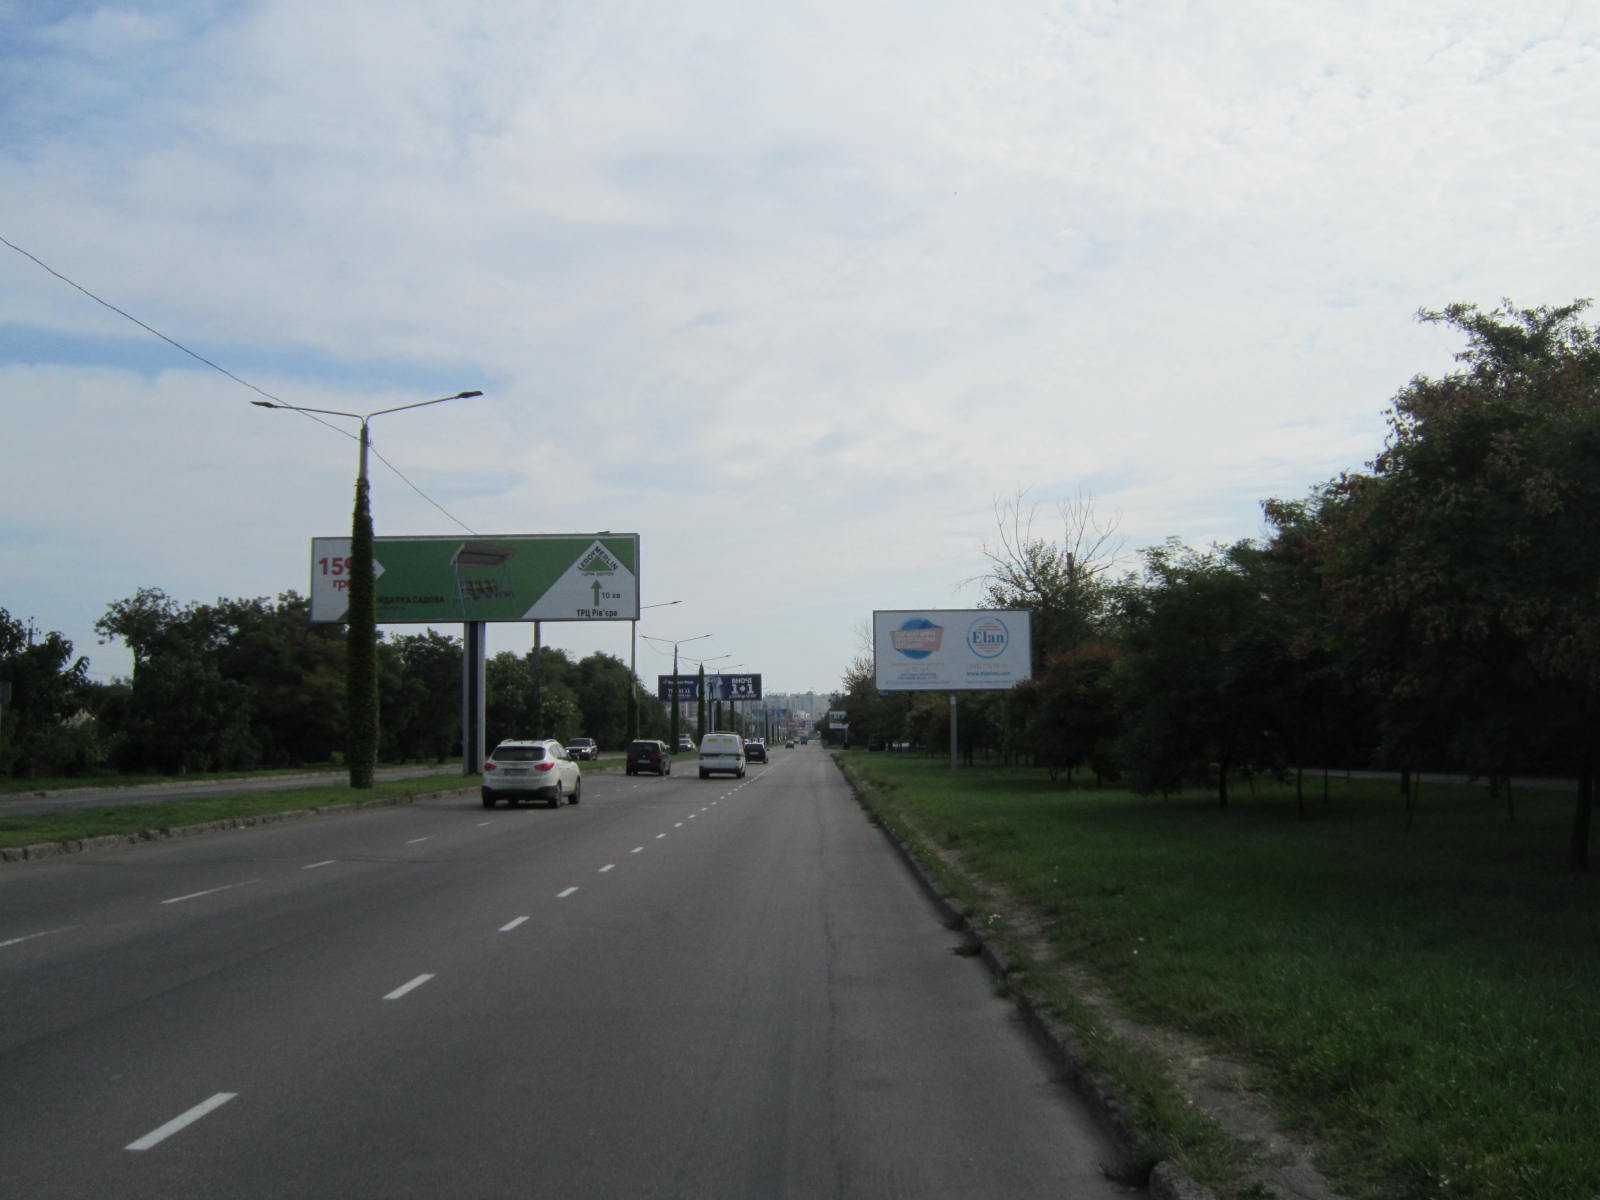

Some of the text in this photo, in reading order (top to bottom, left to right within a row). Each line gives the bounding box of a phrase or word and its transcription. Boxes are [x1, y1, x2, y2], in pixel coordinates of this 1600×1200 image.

[577, 546, 618, 570] LEROY MERLIN
[576, 609, 591, 618] ТРЦ
[973, 631, 1004, 643] Elan
